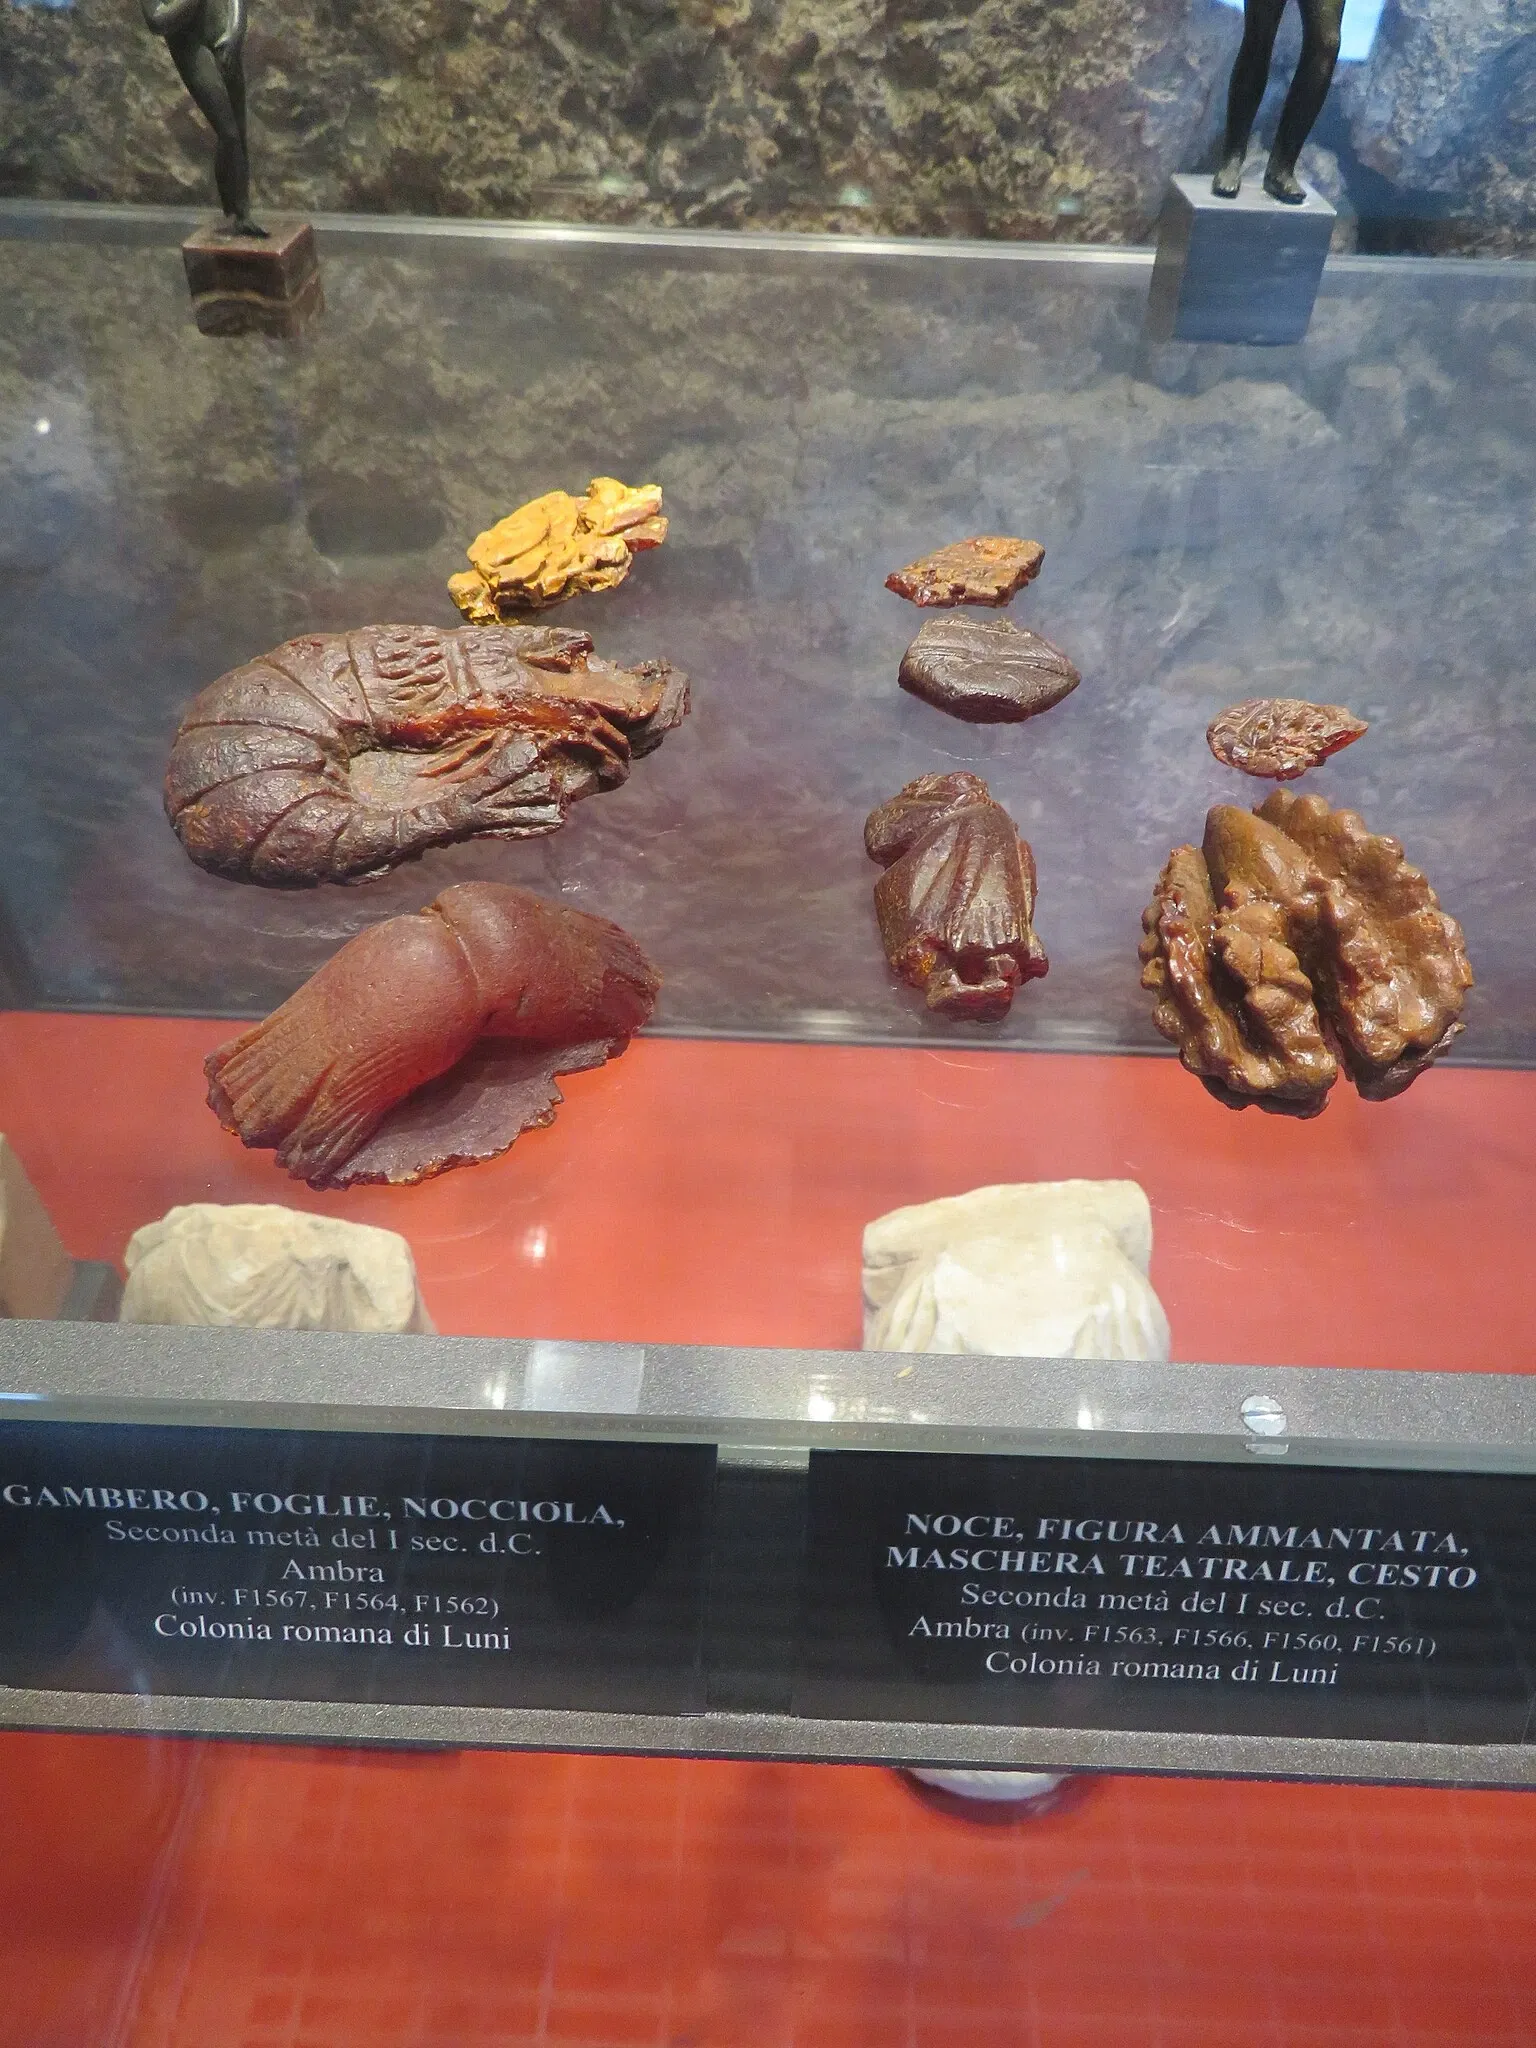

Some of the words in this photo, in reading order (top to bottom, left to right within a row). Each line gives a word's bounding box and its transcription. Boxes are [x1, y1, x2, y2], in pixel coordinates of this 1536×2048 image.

[1, 1484, 220, 1515] GAMBERO,
[232, 1491, 393, 1521] FOGLIE,
[403, 1497, 627, 1529] NOCCIOLA,
[106, 1520, 236, 1544] Seconda
[247, 1526, 321, 1547] metà
[332, 1527, 376, 1549] del
[388, 1529, 398, 1550] I
[411, 1536, 468, 1552] sec.
[479, 1531, 541, 1555] d.C.
[905, 1513, 1023, 1542] NOCE,
[1036, 1518, 1184, 1544] FIGURA
[1197, 1524, 1468, 1557] AMMANTATA,
[280, 1558, 385, 1583] Ambra
[886, 1546, 1105, 1575] MASCHERA
[1120, 1554, 1335, 1588] TEATRALE,
[1347, 1562, 1476, 1589] CESTO
[171, 1586, 226, 1605] (inv.
[234, 1588, 316, 1611] F1567,
[325, 1591, 406, 1614] F1564,
[415, 1594, 499, 1619] F1562)
[961, 1582, 1087, 1609] Seconda
[1097, 1589, 1169, 1612] metà
[1182, 1590, 1224, 1614] del
[1237, 1593, 1248, 1615] I
[1259, 1600, 1312, 1617] sec.
[1326, 1596, 1385, 1620] d.C.
[154, 1613, 272, 1641] Colonia
[282, 1625, 393, 1645] romana
[404, 1622, 431, 1647] di
[443, 1624, 511, 1650] Luni
[909, 1615, 1011, 1640] Ambra
[1022, 1622, 1075, 1644] (inv.
[1083, 1625, 1165, 1646] F1563,
[1174, 1628, 1256, 1648] F1566,
[1264, 1631, 1345, 1653] F1560,
[1353, 1635, 1436, 1657] F1561)
[986, 1650, 1102, 1676] Colonia
[1112, 1661, 1220, 1680] romana
[1231, 1659, 1258, 1682] di
[1270, 1660, 1339, 1685] Luni
